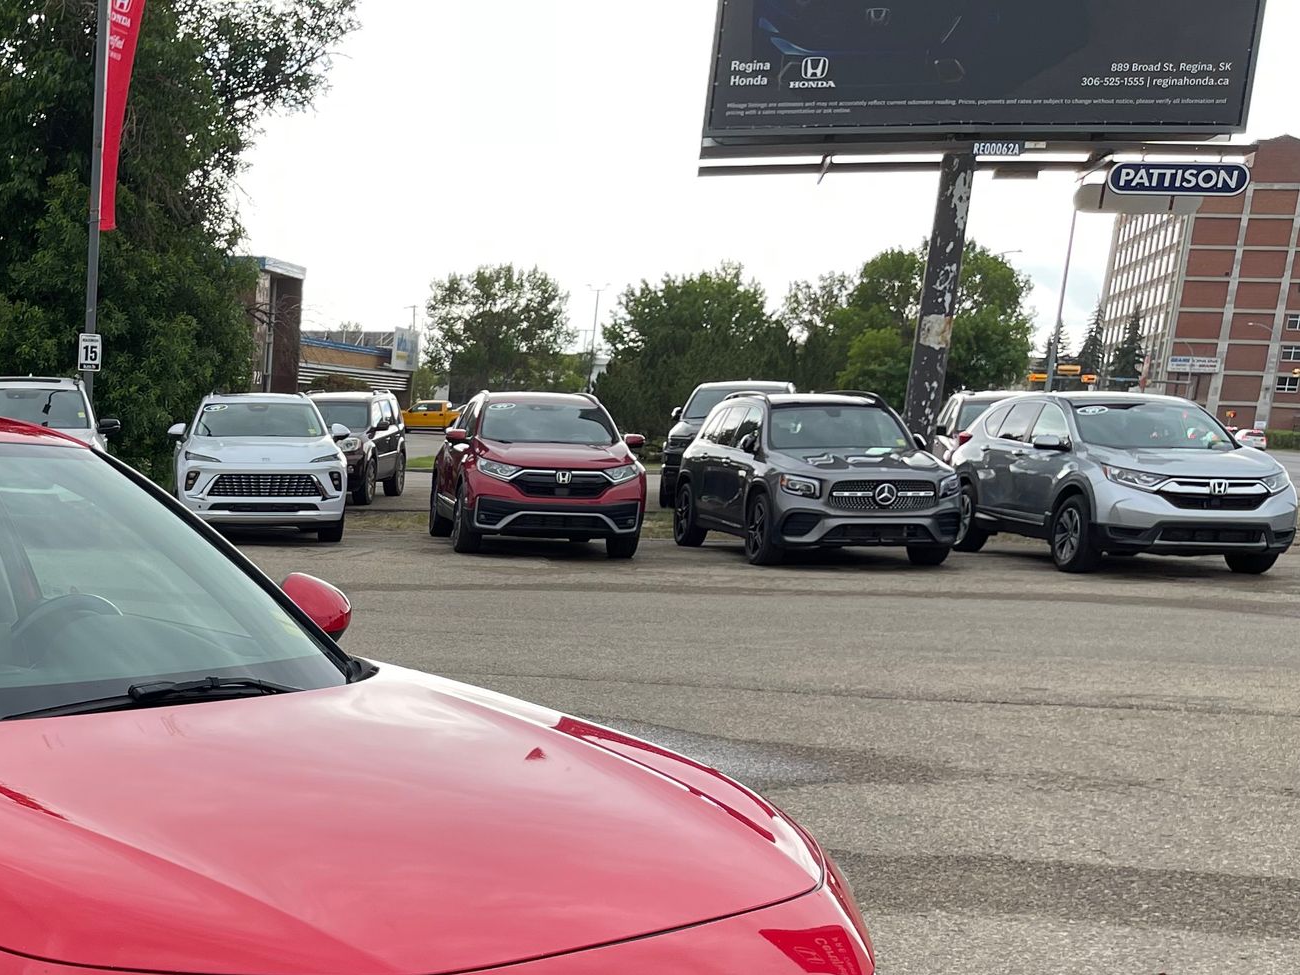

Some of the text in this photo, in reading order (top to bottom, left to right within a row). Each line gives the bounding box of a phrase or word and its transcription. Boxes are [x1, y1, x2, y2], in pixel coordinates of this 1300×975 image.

[730, 60, 771, 73] Regina
[1110, 62, 1233, 73] 889 Broad St, Regina, SK
[730, 75, 768, 86] Honda
[1081, 77, 1145, 86] 306-525-1555
[1152, 76, 1230, 88] reginahonda.ca
[973, 143, 1020, 155] RE00062A
[1119, 168, 1240, 189] PATTISON
[83, 345, 98, 361] 15
